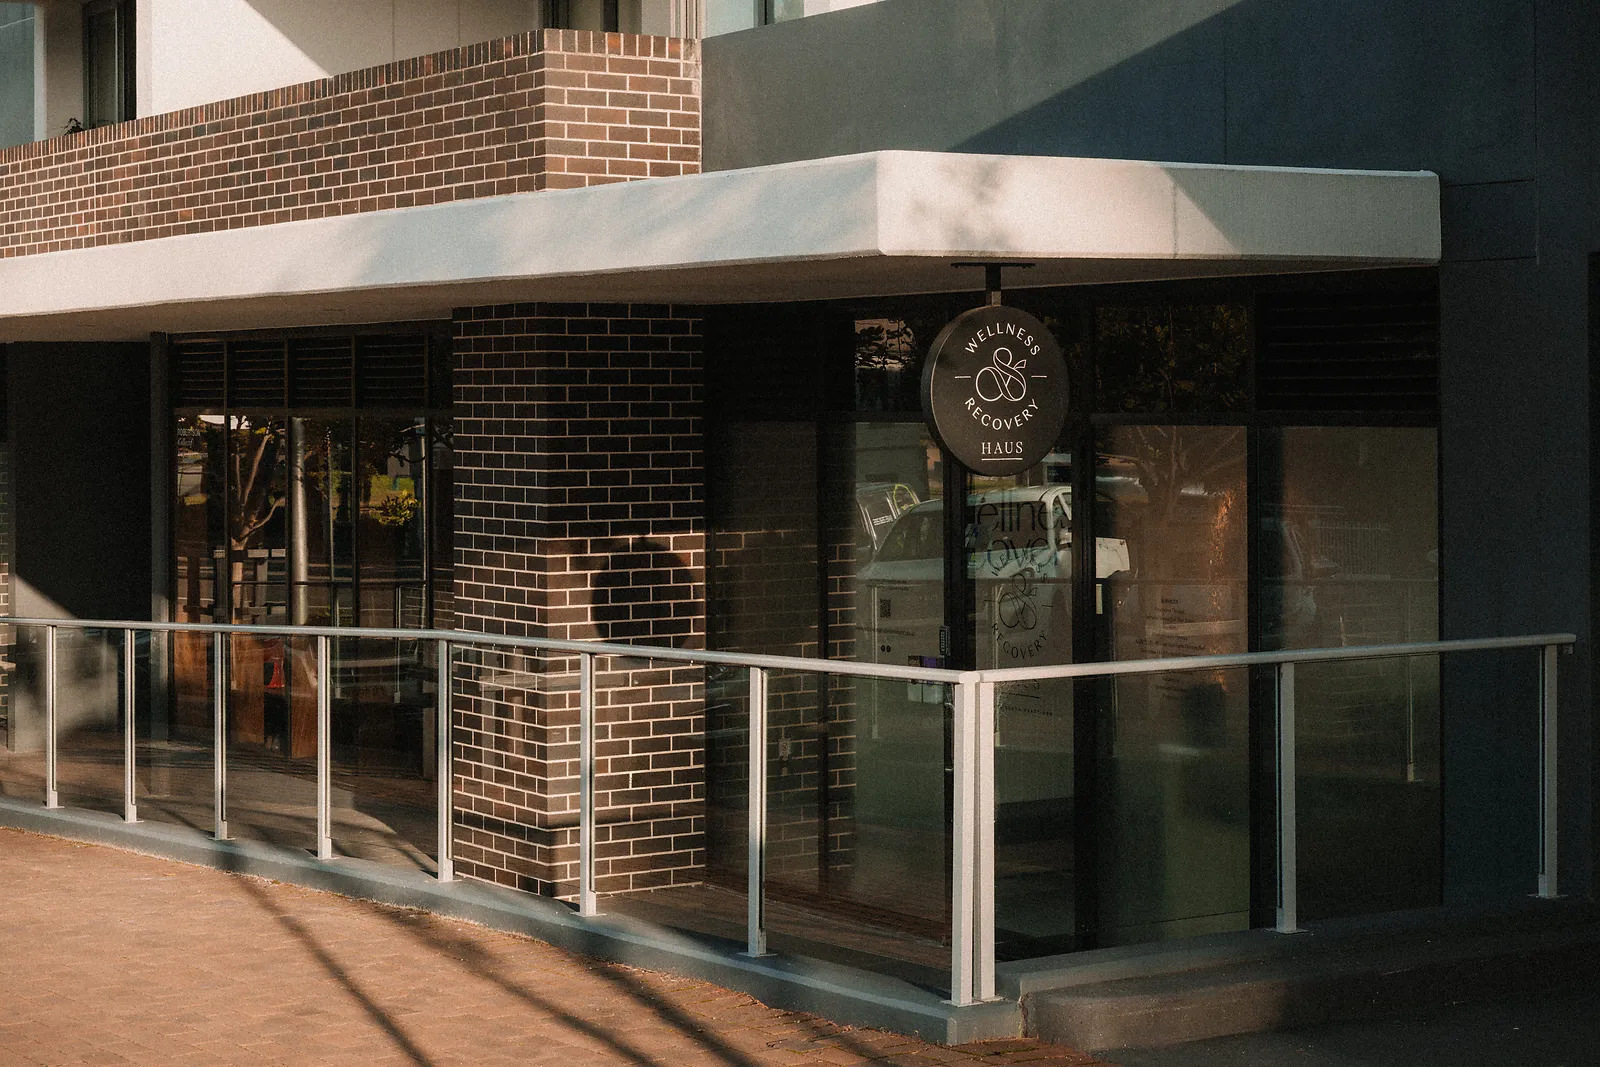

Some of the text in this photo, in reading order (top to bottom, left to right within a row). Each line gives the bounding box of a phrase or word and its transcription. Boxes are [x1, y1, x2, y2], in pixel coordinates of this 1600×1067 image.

[965, 323, 1040, 356] WELLNESS
[965, 397, 1038, 430] RECOVERY
[981, 441, 1023, 454] HAUS
[991, 623, 1048, 660] RECOVERY
